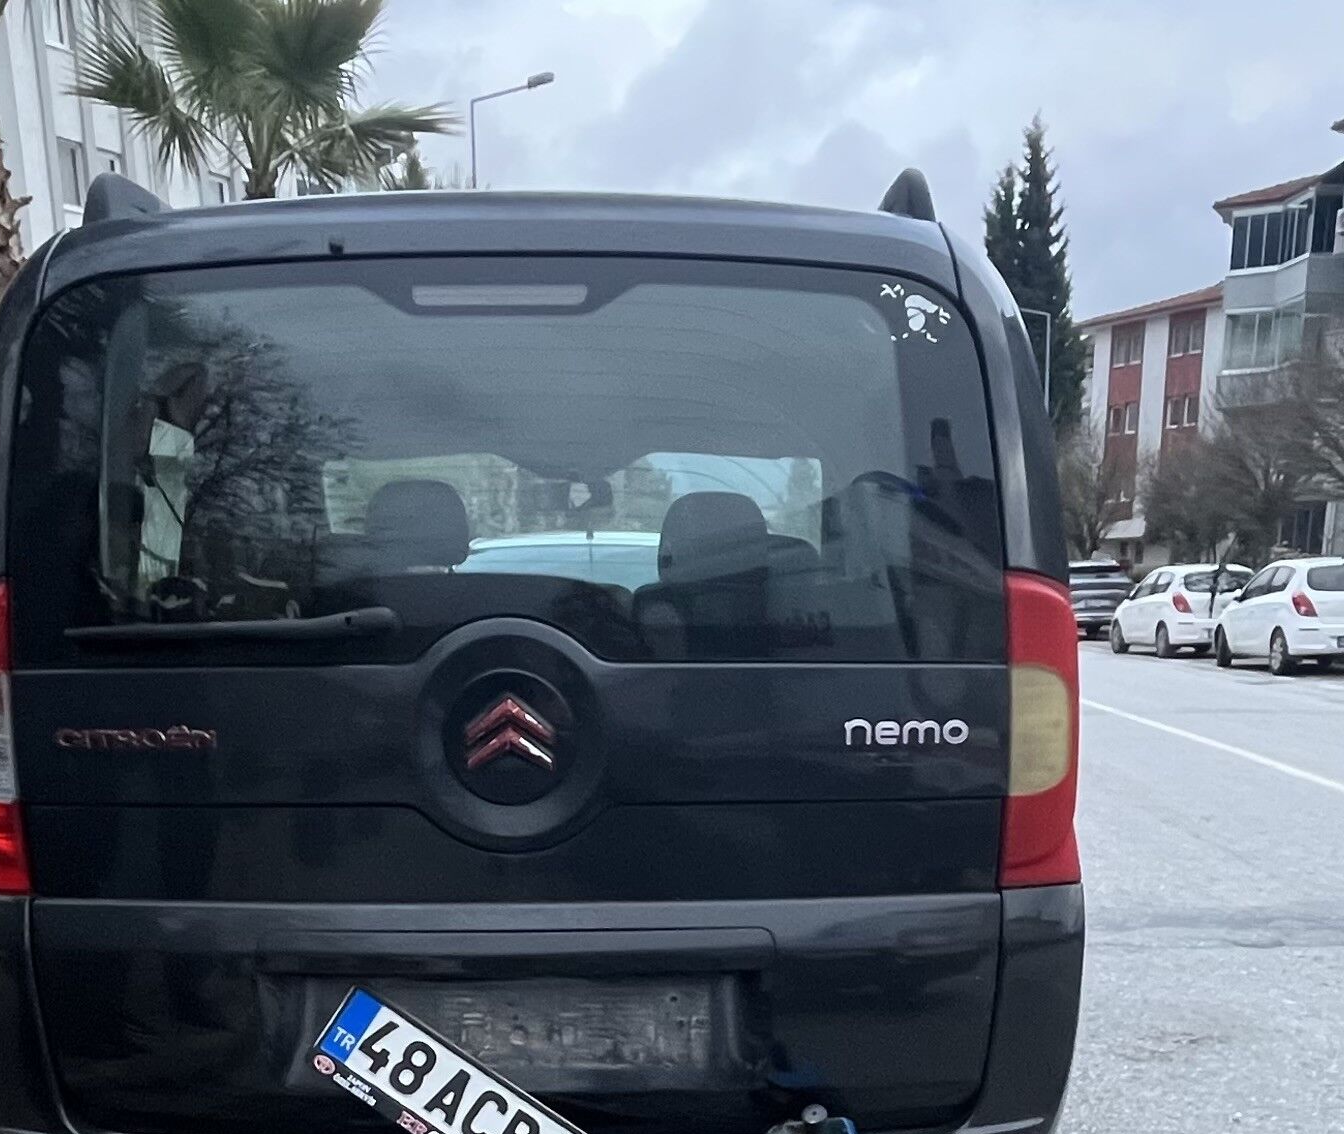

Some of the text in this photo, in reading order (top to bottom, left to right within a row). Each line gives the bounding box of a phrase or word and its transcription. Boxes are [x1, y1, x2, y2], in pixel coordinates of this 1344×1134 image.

[843, 718, 969, 746] nemo
[331, 1026, 356, 1051] TR
[357, 1020, 437, 1096] 48
